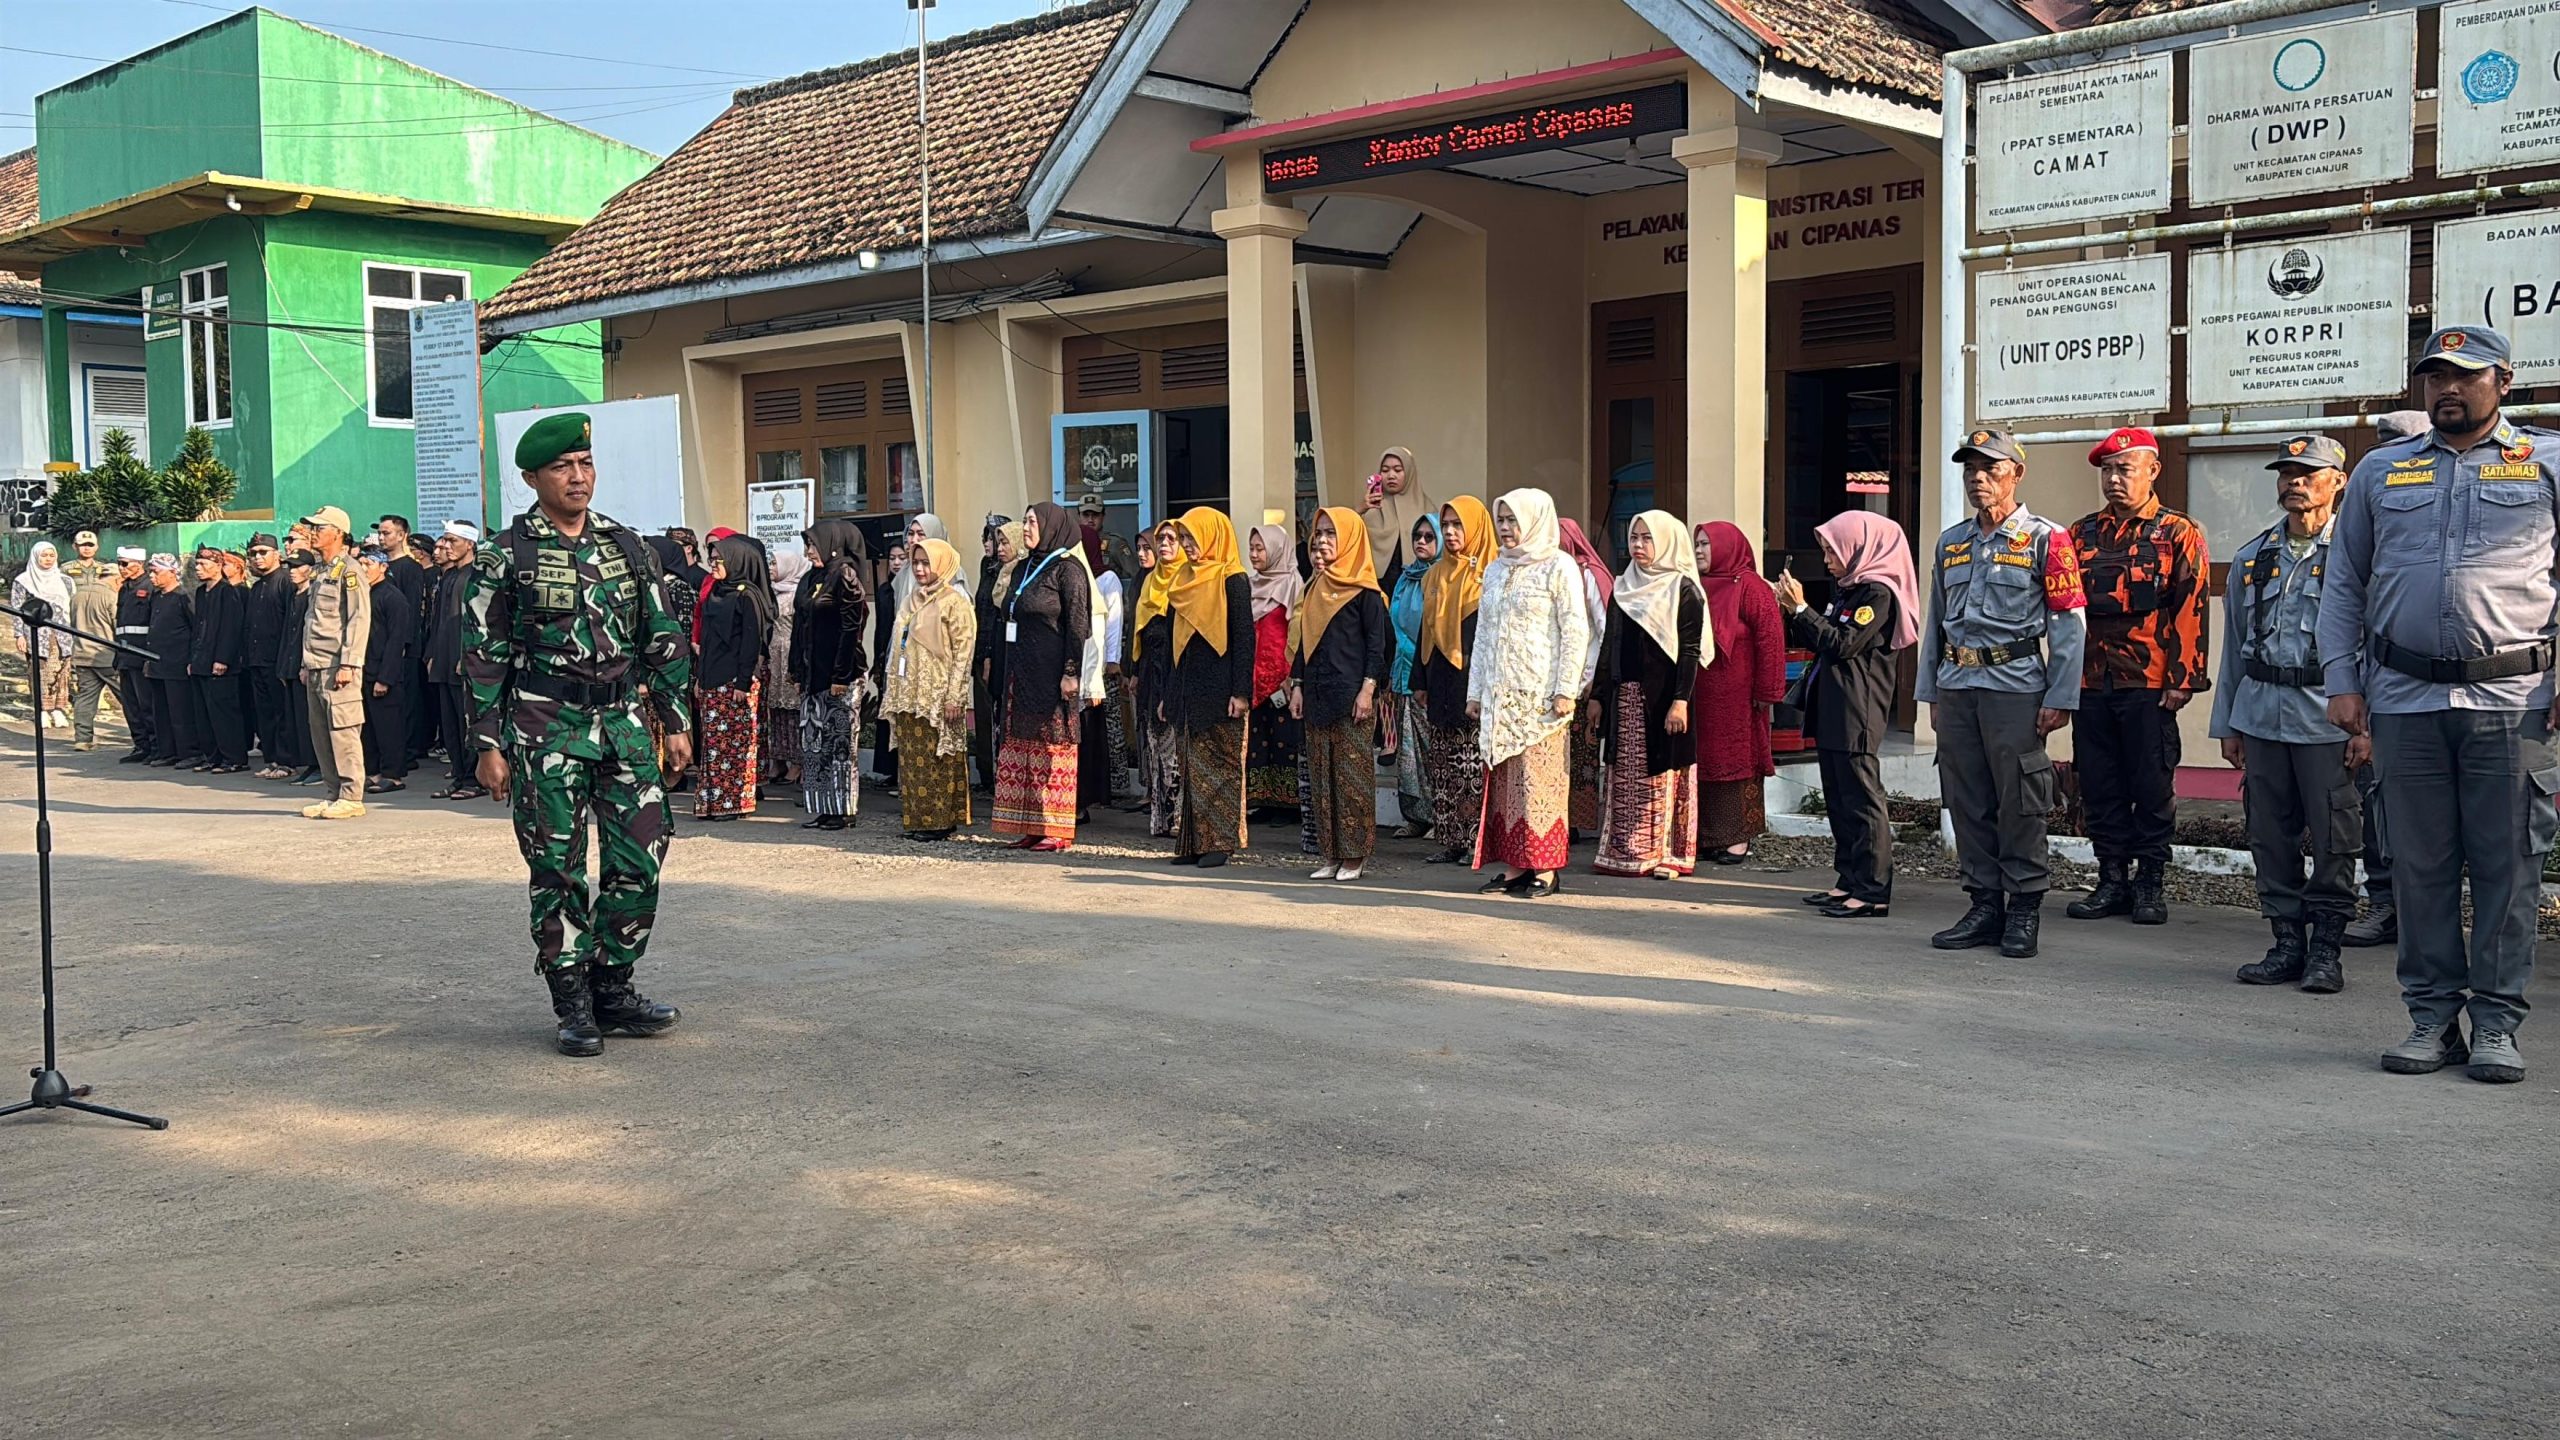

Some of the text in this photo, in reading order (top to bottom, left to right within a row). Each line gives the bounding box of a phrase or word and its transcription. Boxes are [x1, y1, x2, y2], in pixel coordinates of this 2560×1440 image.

[2456, 9, 2526, 28] PEMBERDAYAAN
[2528, 3, 2546, 15] DAN
[1989, 69, 2158, 104] PEJABAT PEMBUAT AKTA TANAH
[2039, 91, 2105, 108] SEMENTARA
[2207, 87, 2393, 125] DHARMA WANITA PERSATUAN
[2515, 110, 2535, 120] TIM
[2033, 150, 2109, 175] CAMAT
[2233, 147, 2363, 171] UNIT KECAMATAN CIPANAS
[2245, 162, 2349, 184] KABUPATEN CIANJUR
[1988, 188, 2157, 216] KECAMATAN CIPANAS KABUPATEN CIANJUR
[1603, 211, 1688, 241] PELAYAN
[1801, 215, 1901, 246] CIPANAS
[2486, 226, 2536, 242] BADAN
[2018, 272, 2127, 292] UNIT OPERASIONAL
[1989, 282, 2156, 307] PENANGGULANGAN BENCANA
[2026, 300, 2117, 317] DAN PENGUNGSI
[2201, 300, 2393, 325] KORPS PEGAWAI REPUBLIK INDONESIA
[2246, 322, 2343, 347] KORPRI
[2055, 338, 2091, 361] OPS
[2249, 349, 2342, 363] PENGURUS KORPRI
[2229, 360, 2360, 377] UNIT KECAMATAN CIPANAS
[2511, 358, 2555, 370] CIPANAS
[2242, 376, 2345, 390] KABUPATEN CIANJUR
[1988, 388, 2155, 407] KECAMATAN CIPANAS KABUPATEN CIANJUR
[2482, 464, 2536, 478] SATLINMAS
